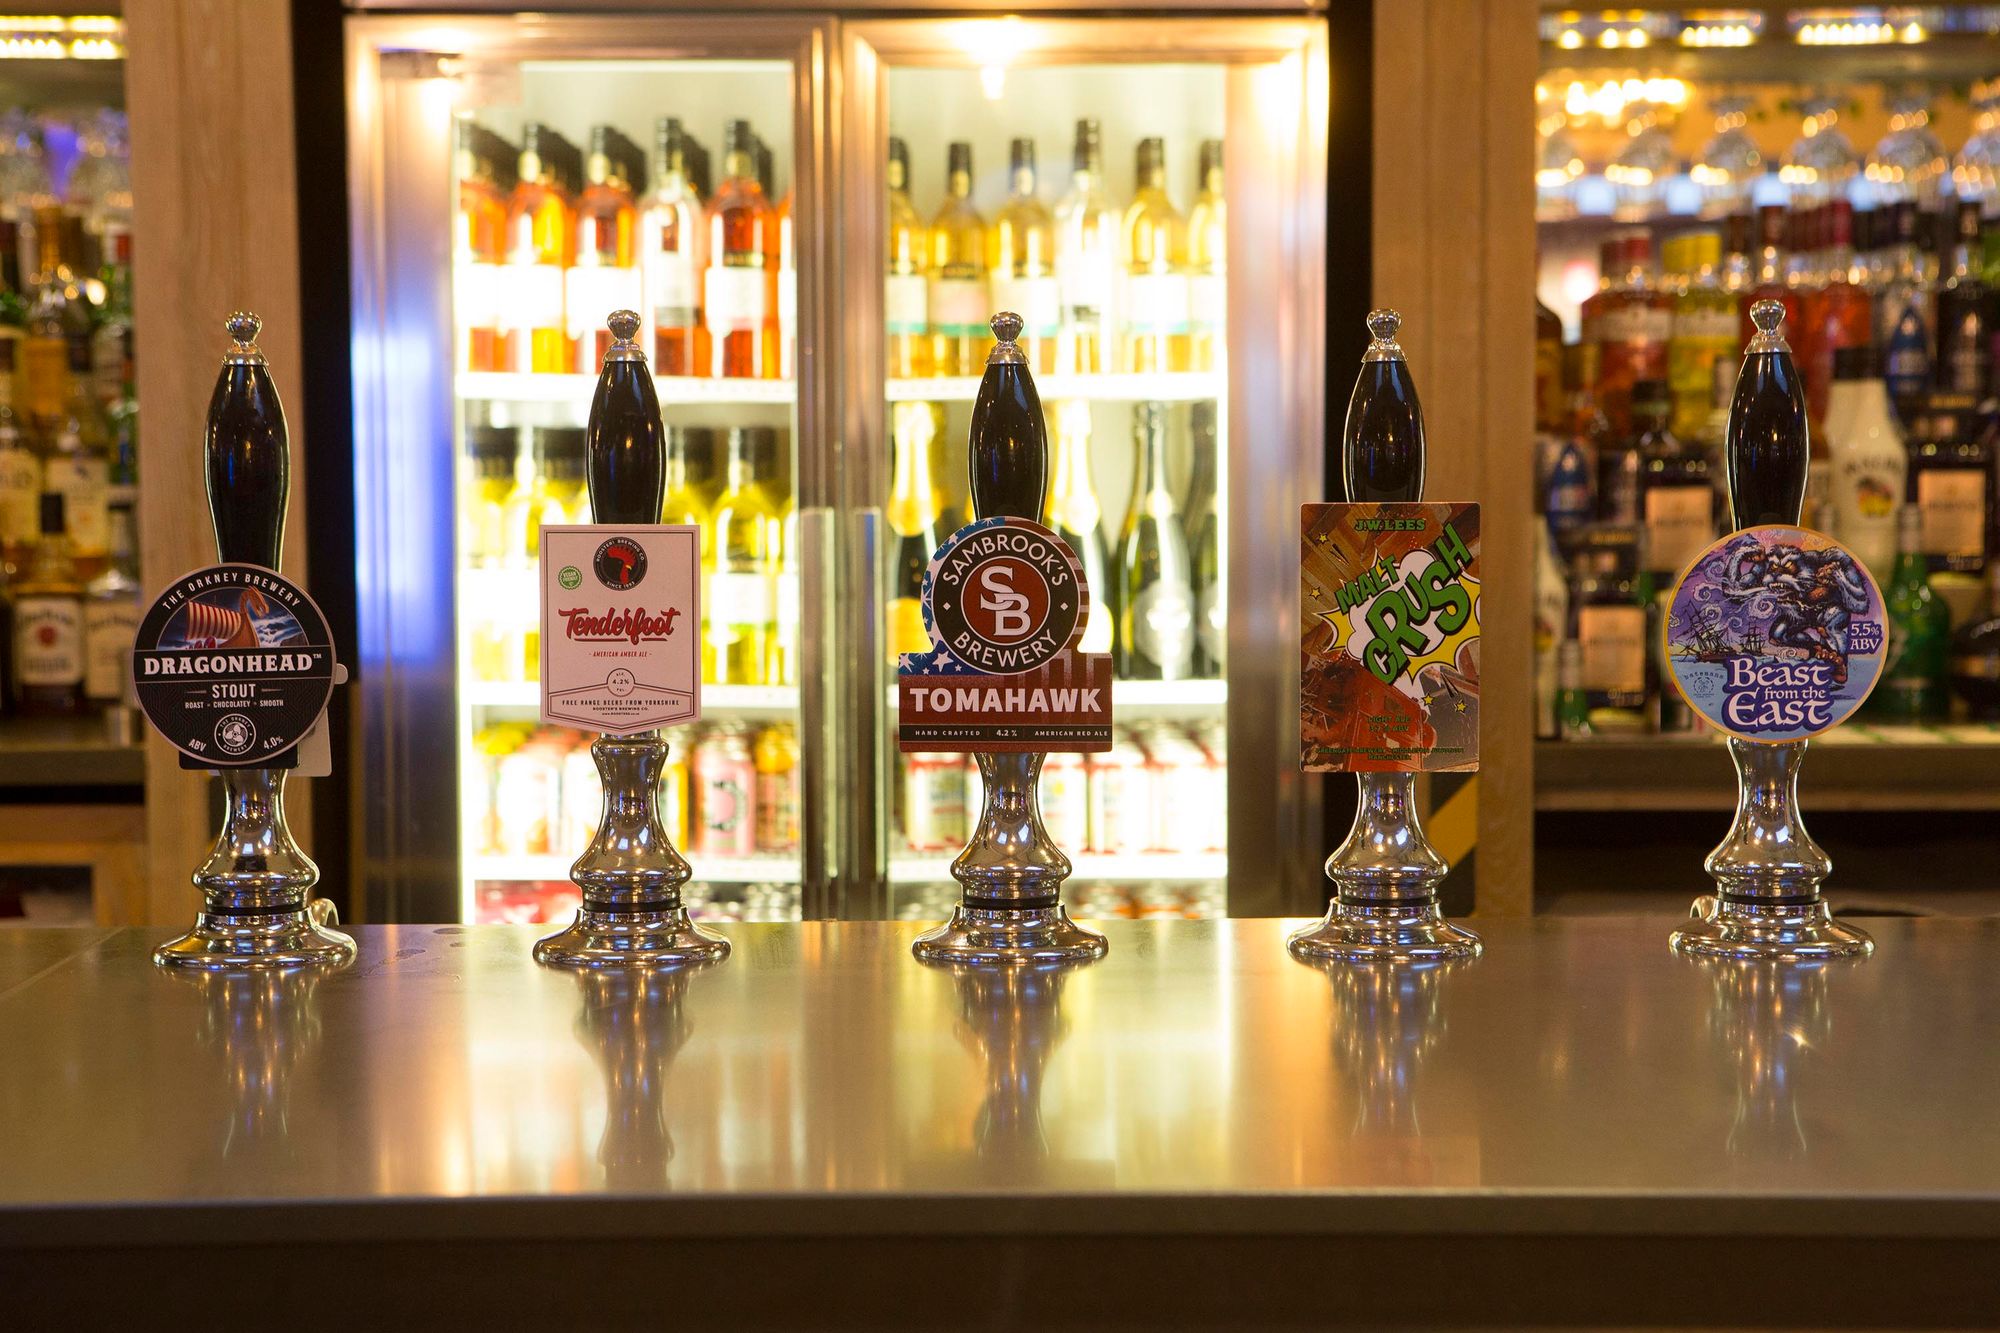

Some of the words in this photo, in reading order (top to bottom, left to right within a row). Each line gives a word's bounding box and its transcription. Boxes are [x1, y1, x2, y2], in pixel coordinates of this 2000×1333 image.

[1384, 519, 1426, 531] LEES
[943, 534, 1068, 586] SAMBROOK'S
[162, 590, 184, 610] THE
[188, 573, 237, 592] ORKNEY
[245, 574, 301, 607] BREWERY
[607, 581, 622, 589] SINCE
[1334, 555, 1400, 615] MALT
[1362, 522, 1473, 686] CRUSH
[558, 607, 681, 646] Tenderfoot
[1851, 624, 1880, 636] 5.5%
[954, 628, 1057, 667] BREWERY
[1851, 638, 1882, 650] ABV
[1729, 658, 1830, 687] Beast
[212, 684, 256, 699] STOUT
[909, 687, 1102, 713] TOMAHAWK
[1764, 687, 1798, 700] from
[1802, 686, 1826, 699] the
[1728, 687, 1830, 727] East
[189, 739, 206, 752] ABV
[263, 736, 283, 749] 4.0%
